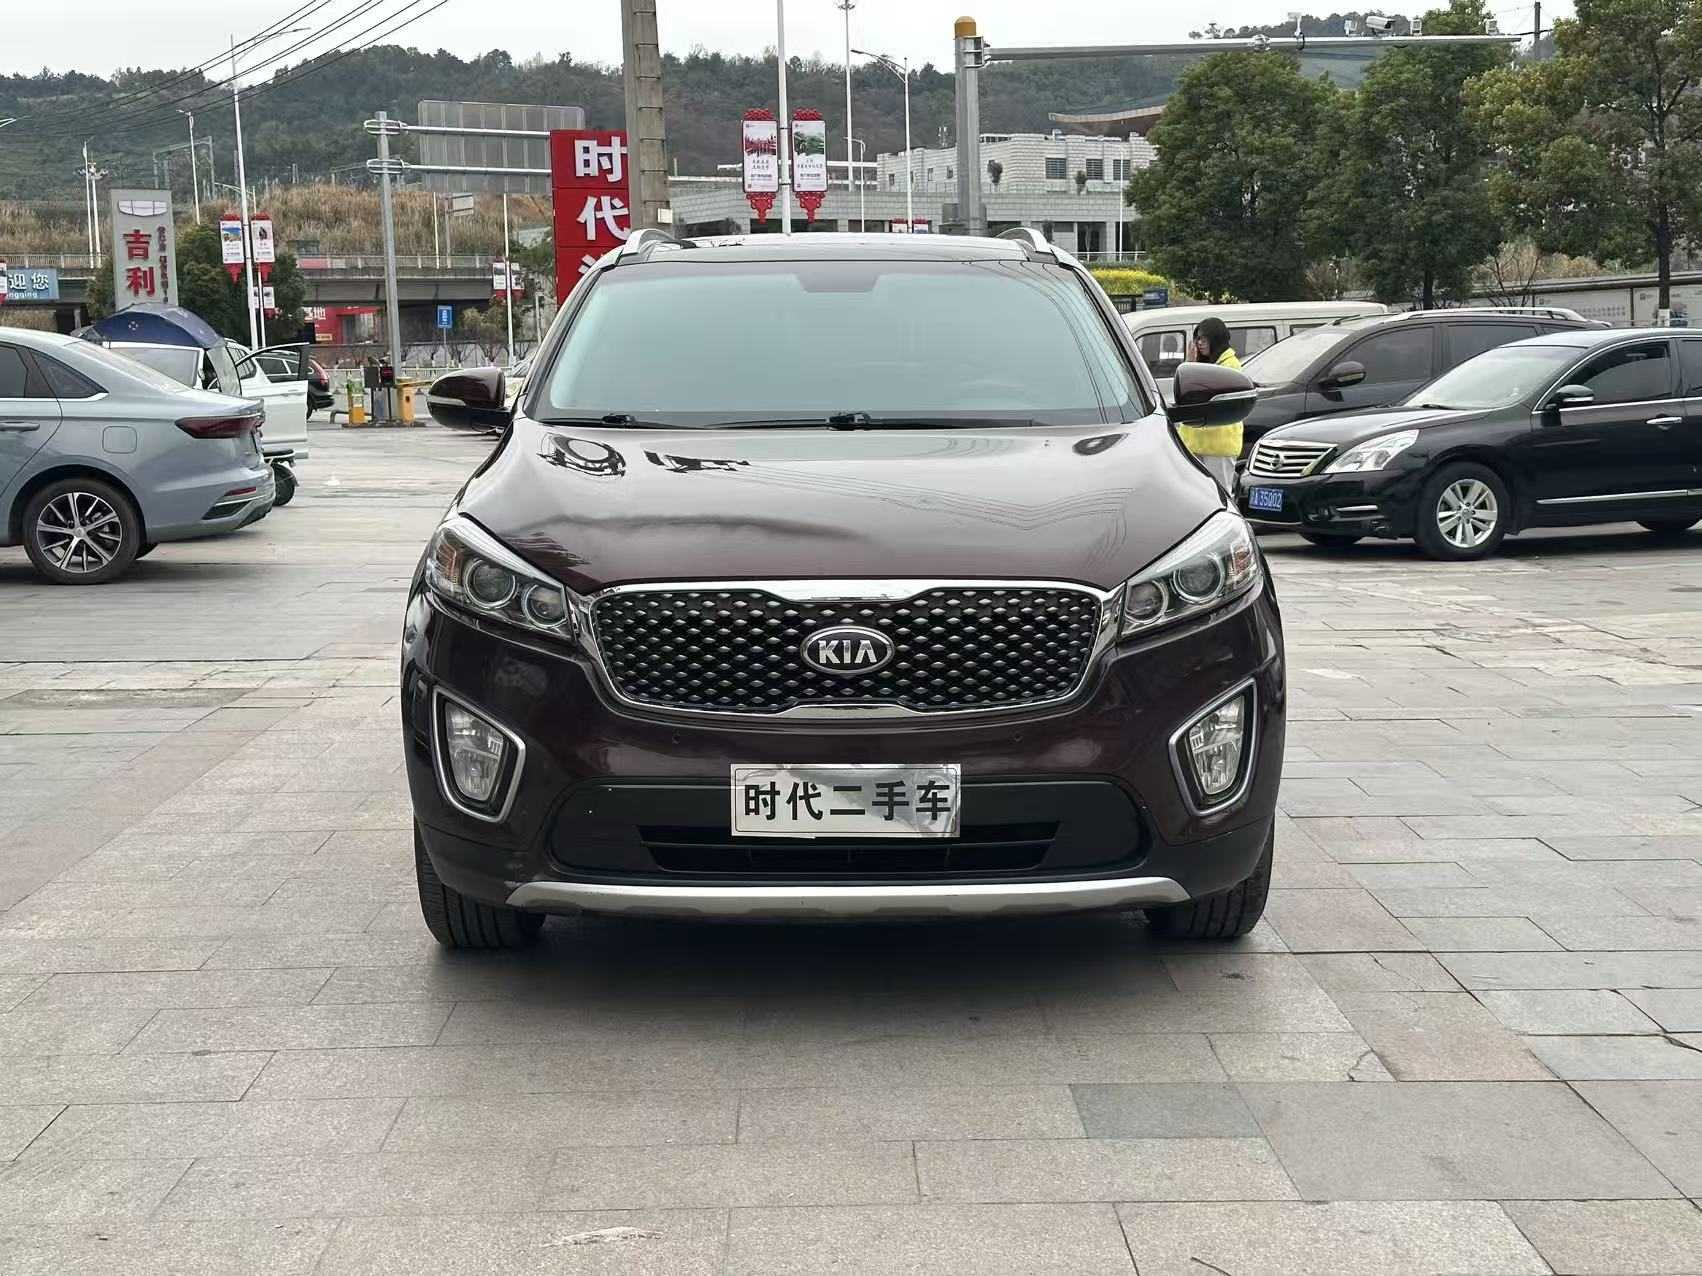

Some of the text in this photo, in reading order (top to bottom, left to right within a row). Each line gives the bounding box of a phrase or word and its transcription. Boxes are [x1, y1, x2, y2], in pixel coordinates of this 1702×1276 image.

[574, 136, 631, 274] 时代
[122, 229, 156, 297] 吉利
[817, 640, 877, 664] KIA
[744, 780, 951, 821] 时代二手车
